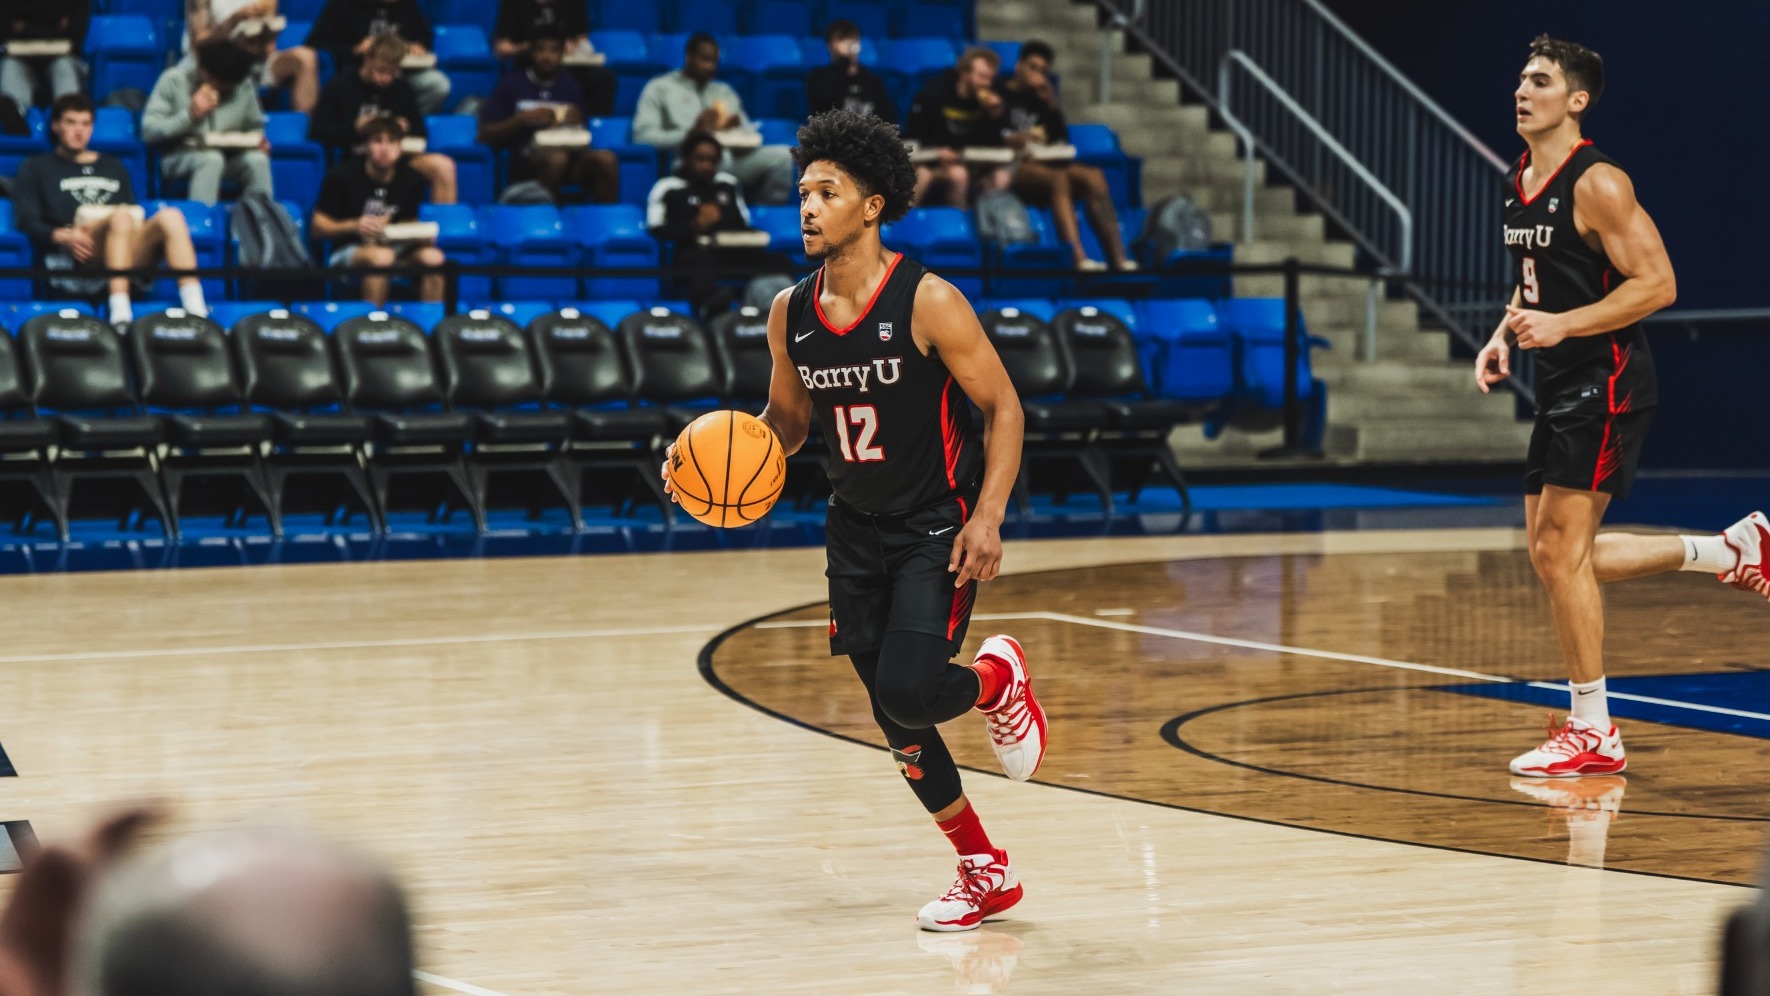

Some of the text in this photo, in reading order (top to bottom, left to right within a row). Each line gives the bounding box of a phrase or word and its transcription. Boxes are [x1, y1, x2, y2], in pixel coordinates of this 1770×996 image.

[1535, 224, 1554, 248] U
[1522, 256, 1540, 304] 9
[797, 357, 902, 392] Barry U
[834, 405, 886, 462] 12
